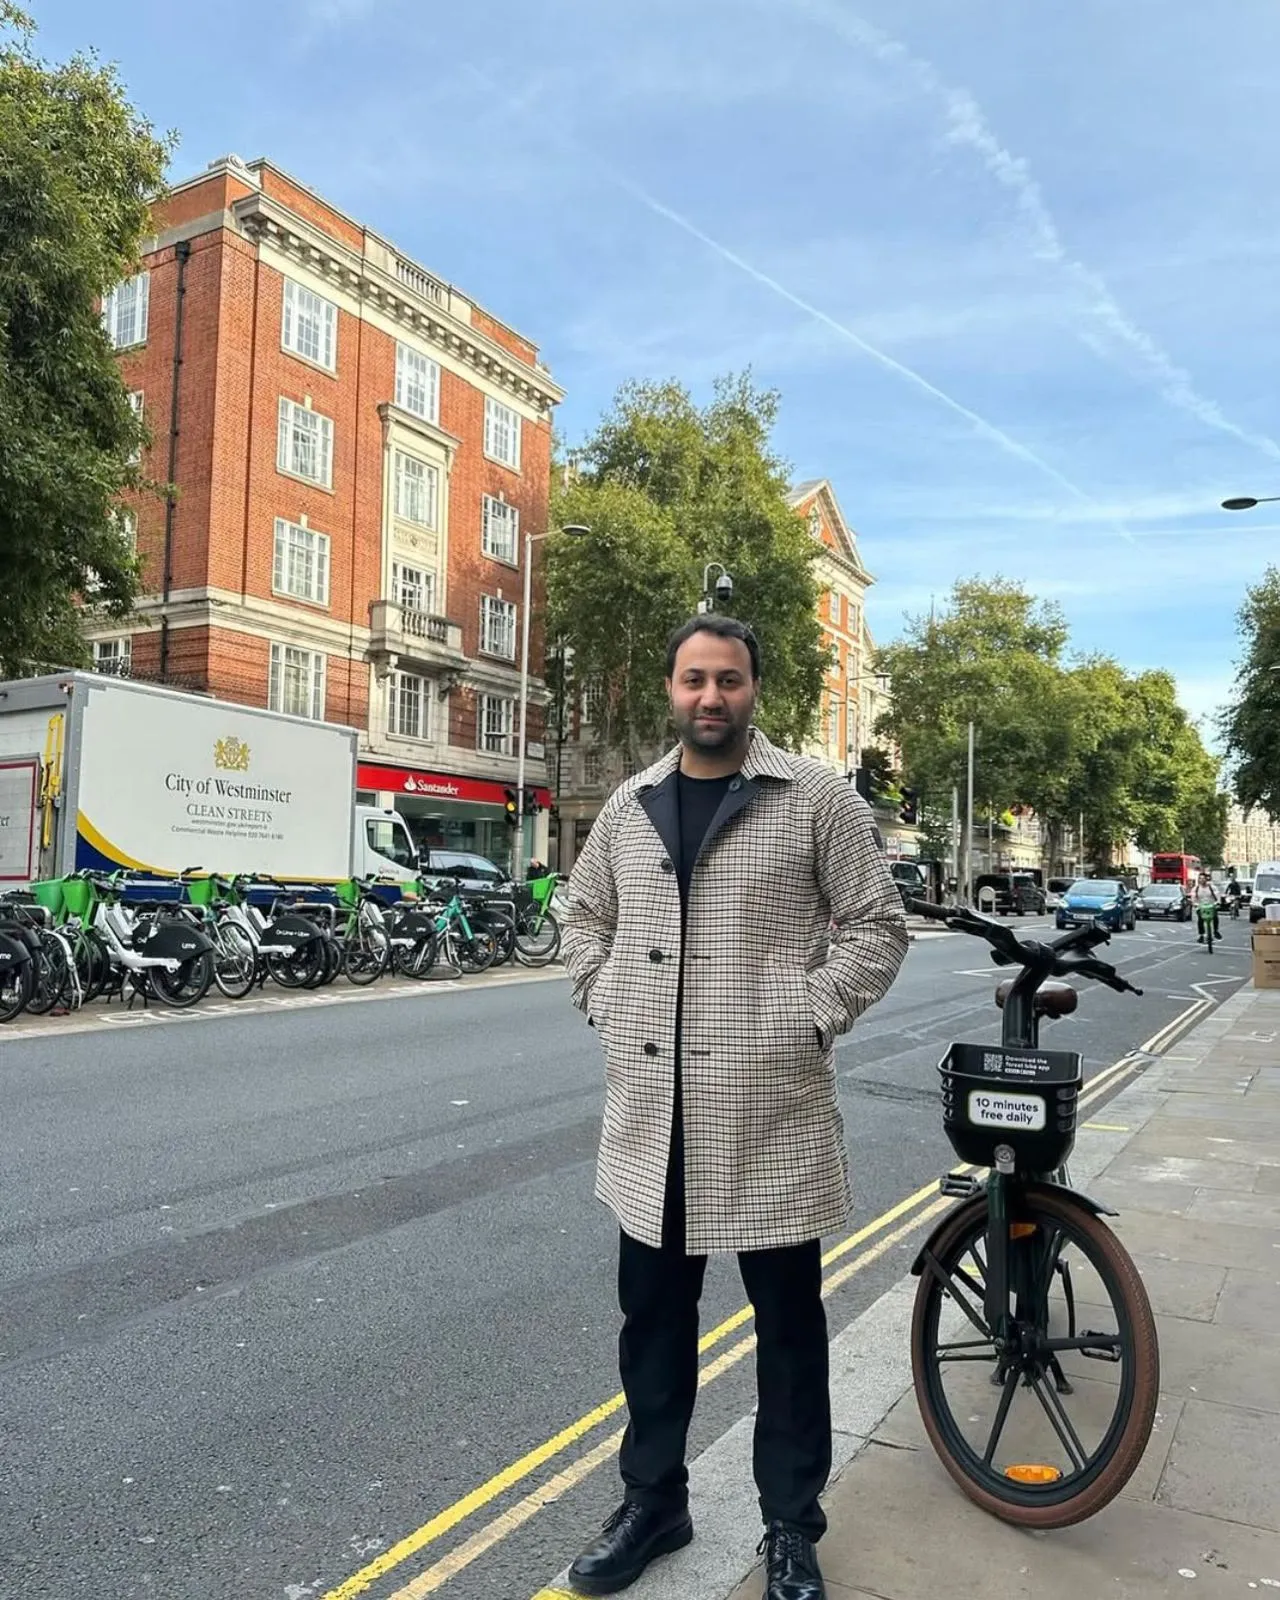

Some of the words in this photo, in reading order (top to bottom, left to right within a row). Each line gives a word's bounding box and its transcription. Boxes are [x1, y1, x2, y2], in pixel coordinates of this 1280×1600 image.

[165, 773, 193, 797] City
[196, 777, 212, 794] of
[214, 779, 292, 803] Westminster
[417, 779, 460, 795] Santander
[186, 803, 225, 818] CLEAN
[227, 807, 273, 822] STREETS
[975, 1097, 990, 1108] 10
[993, 1100, 1039, 1112] minutes
[981, 1109, 1003, 1121] free
[1006, 1111, 1033, 1126] daily
